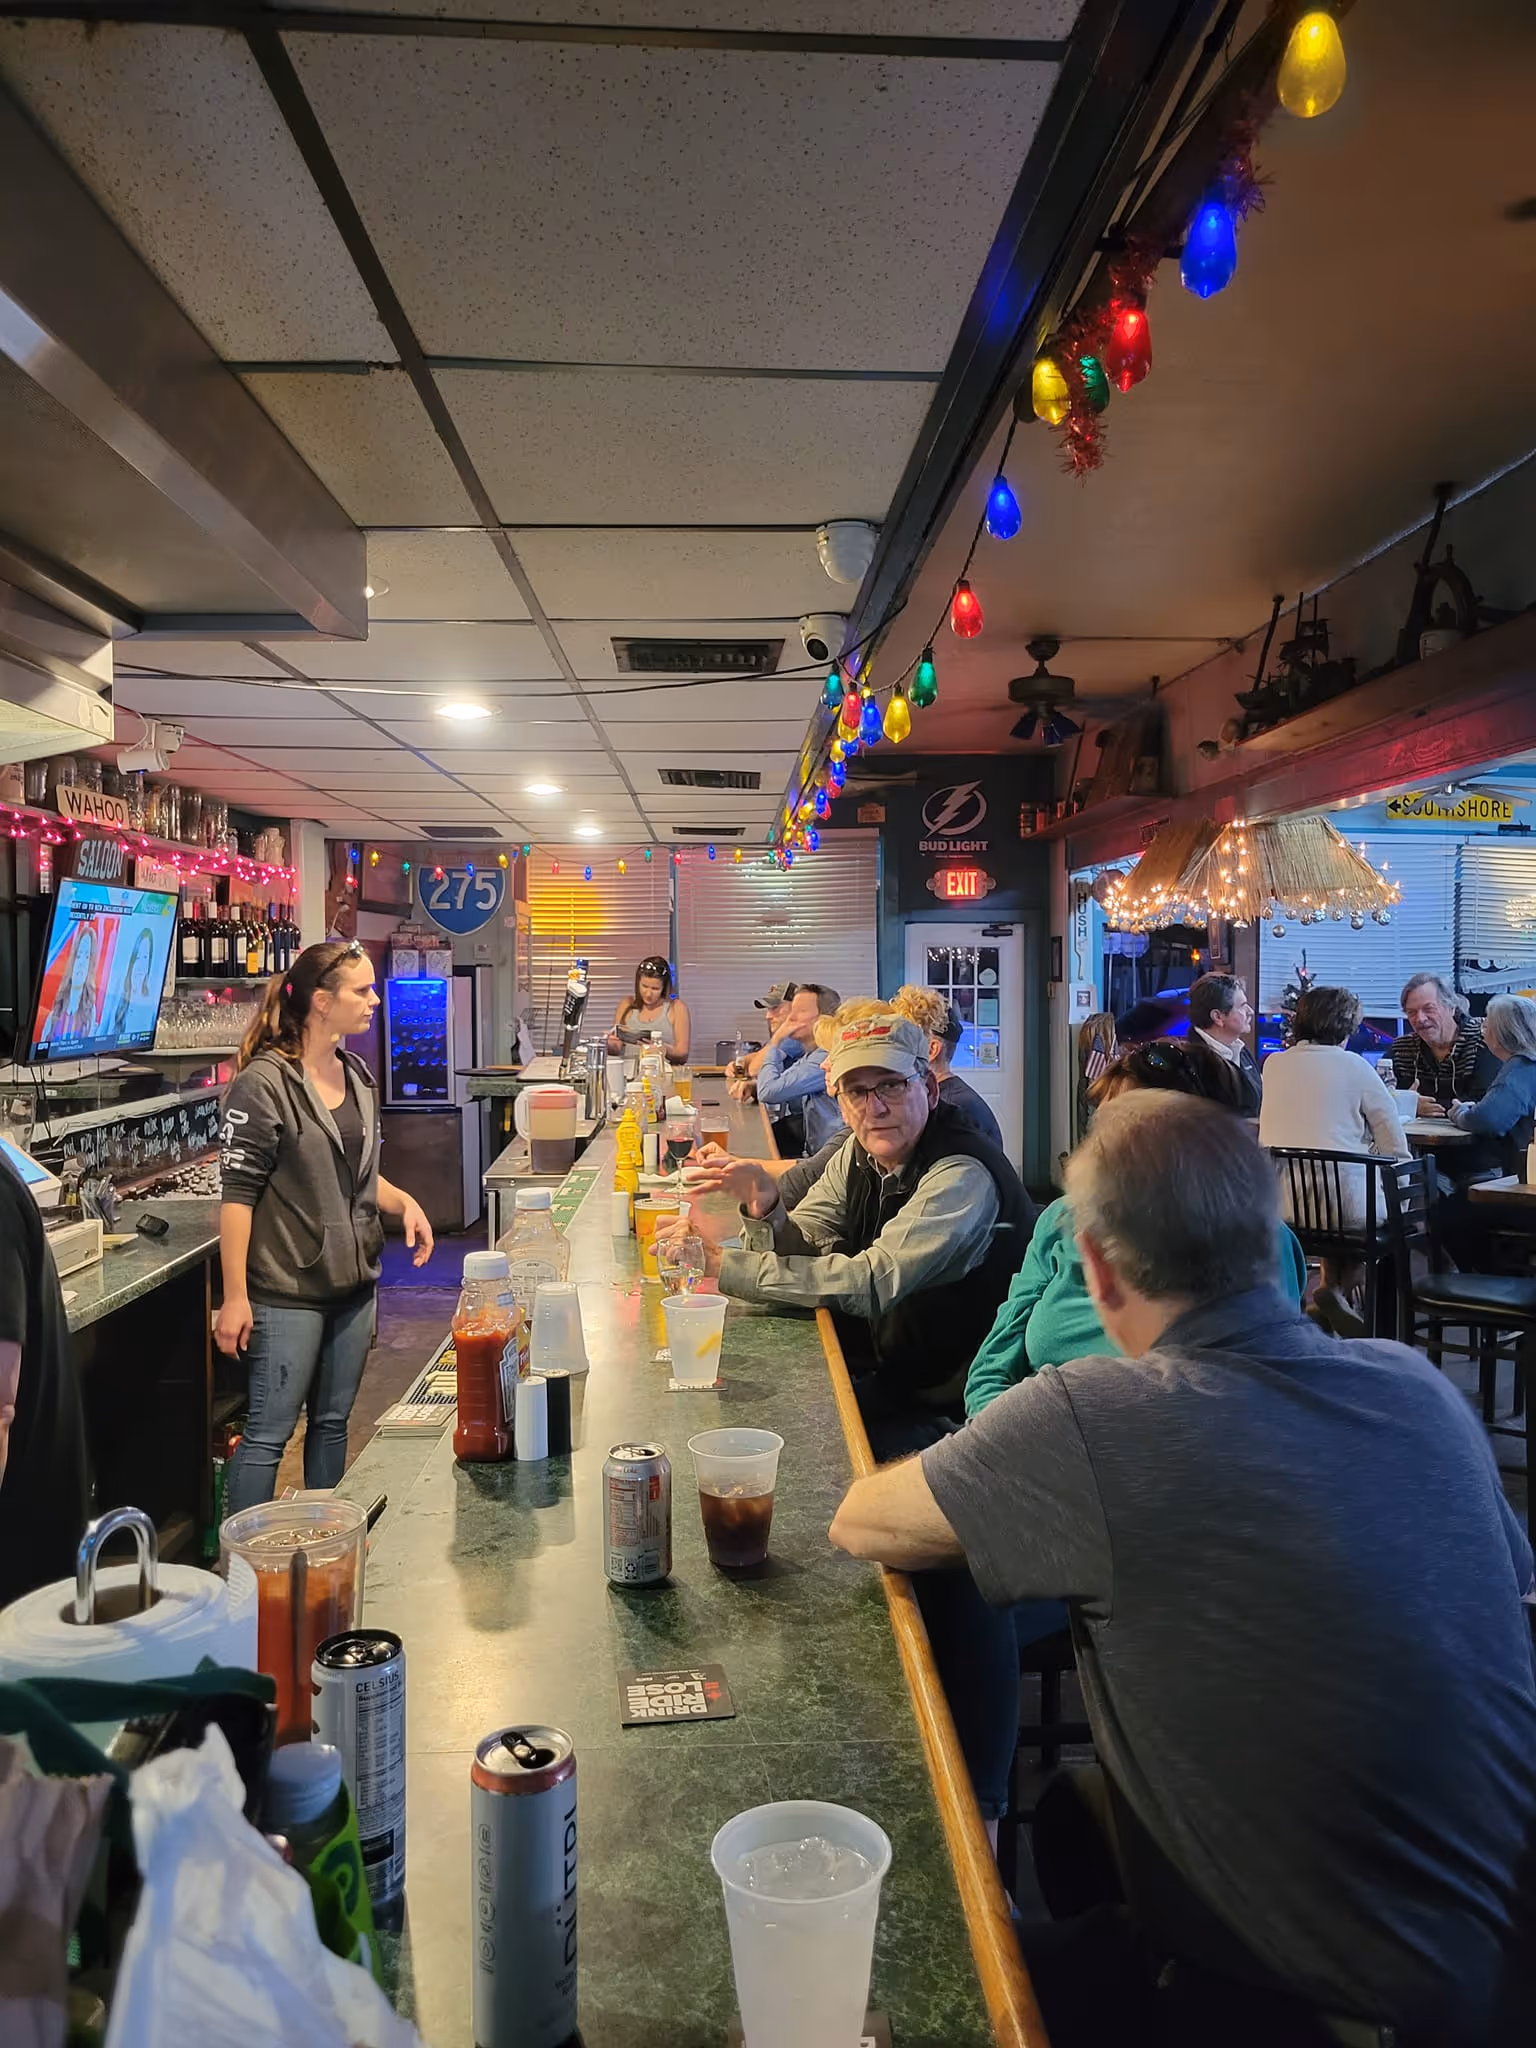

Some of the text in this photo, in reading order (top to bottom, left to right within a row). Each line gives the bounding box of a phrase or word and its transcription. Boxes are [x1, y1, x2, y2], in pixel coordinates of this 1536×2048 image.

[65, 790, 124, 821] WAHOO
[919, 841, 988, 851] BUD LIGHT
[77, 839, 124, 880] SALOON
[428, 872, 497, 910] 275
[946, 871, 978, 896] EXIT
[1077, 892, 1088, 937] HUSH
[356, 1670, 399, 1693] CELSIUS
[626, 1680, 704, 1697] LOSE
[627, 1692, 706, 1711] RIDE
[630, 1704, 708, 1718] DRINK
